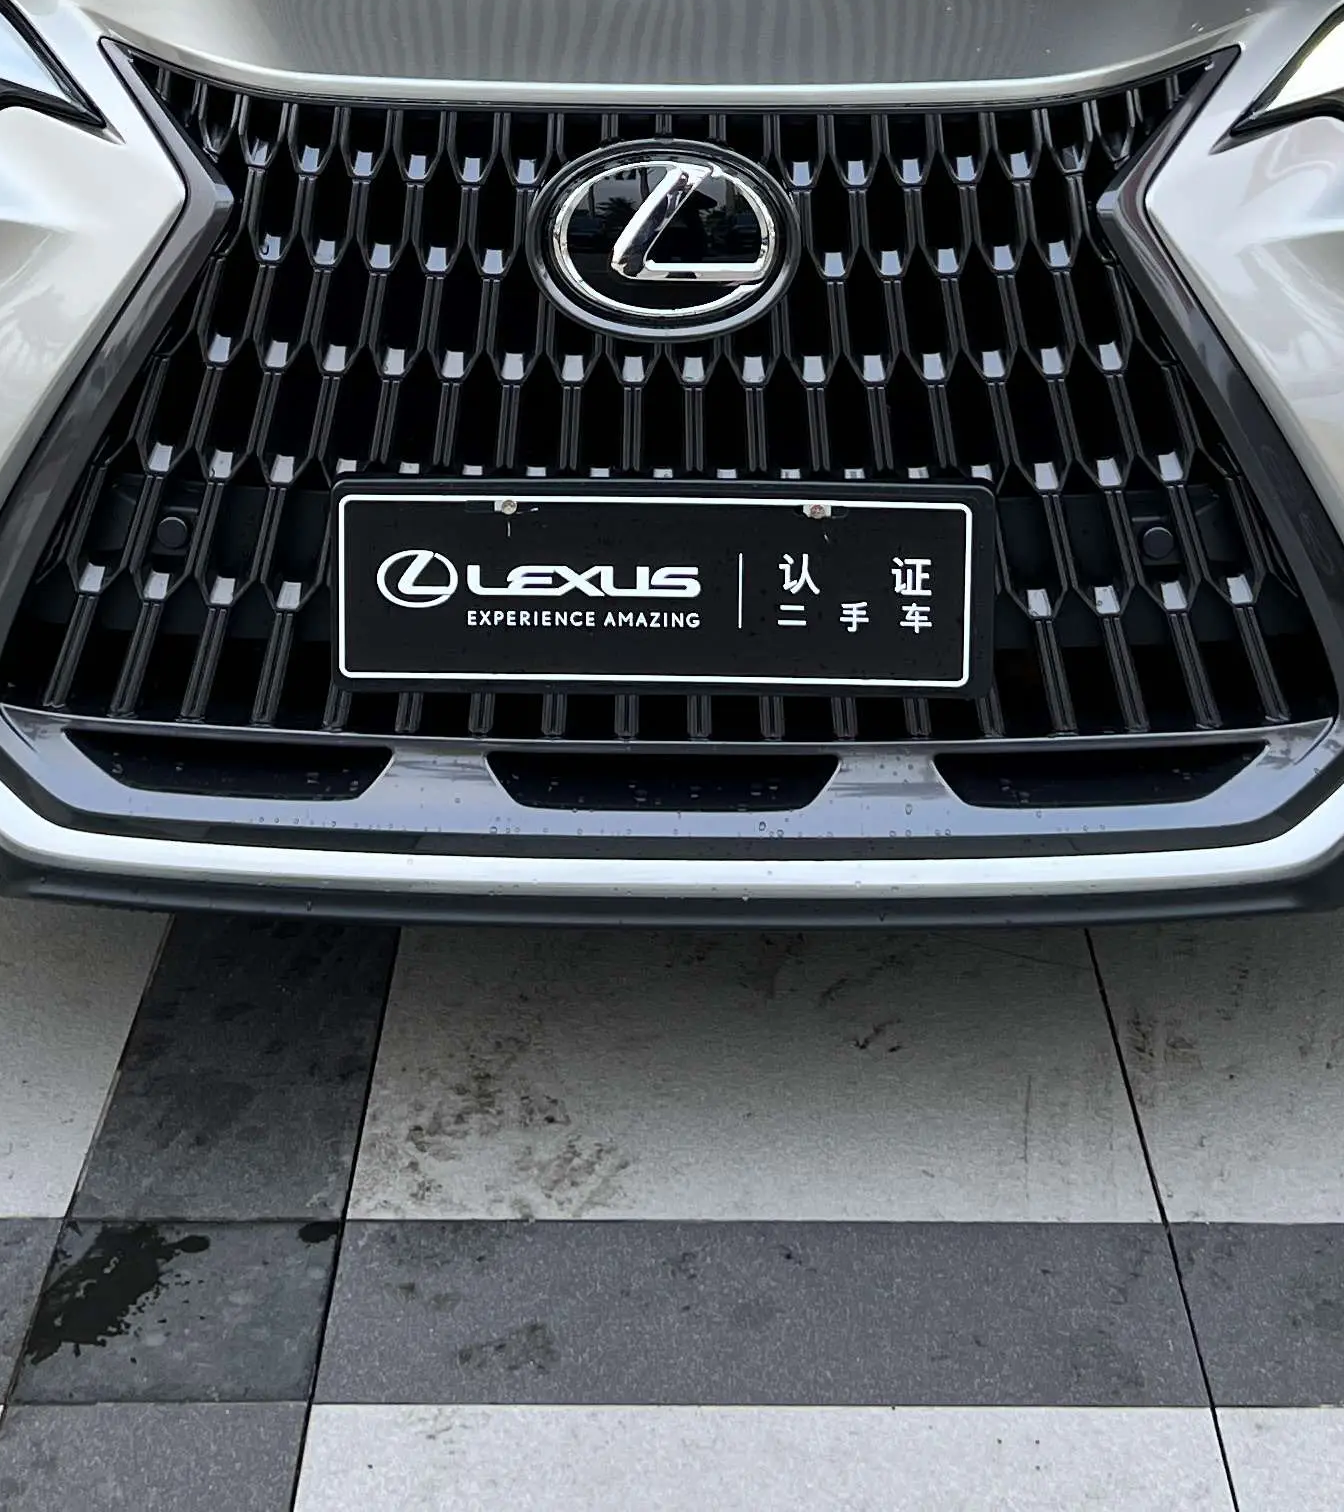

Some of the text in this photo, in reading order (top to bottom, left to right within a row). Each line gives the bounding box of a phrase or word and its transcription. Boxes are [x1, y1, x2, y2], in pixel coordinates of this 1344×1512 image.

[466, 564, 701, 598] LEXUS
[778, 553, 933, 598] 认证
[466, 610, 701, 629] EXPERIENCE AMAZING
[777, 601, 933, 634] 二手车
